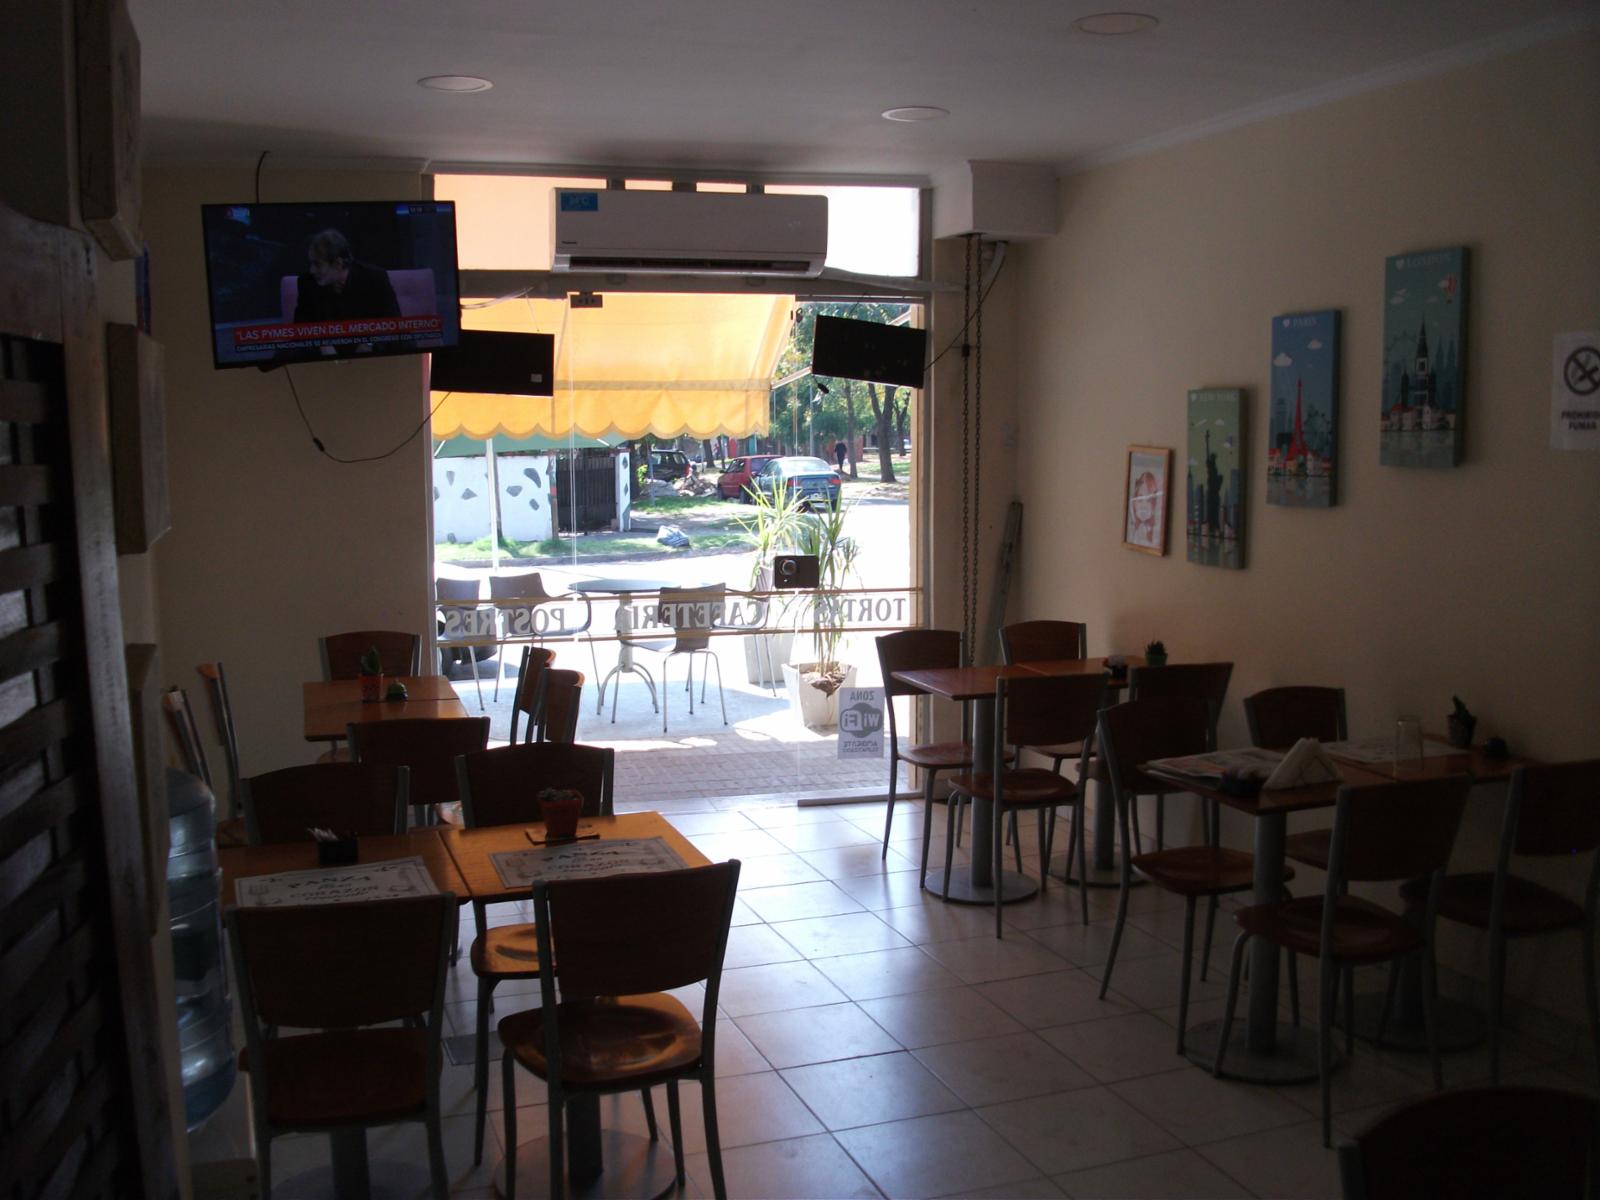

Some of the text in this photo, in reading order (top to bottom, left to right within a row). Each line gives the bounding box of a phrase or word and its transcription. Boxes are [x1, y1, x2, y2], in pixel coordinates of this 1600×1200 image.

[261, 327, 294, 339] PYMES
[297, 325, 326, 337] VIVEN
[328, 323, 345, 335] DEL
[348, 320, 397, 333] MERCADO
